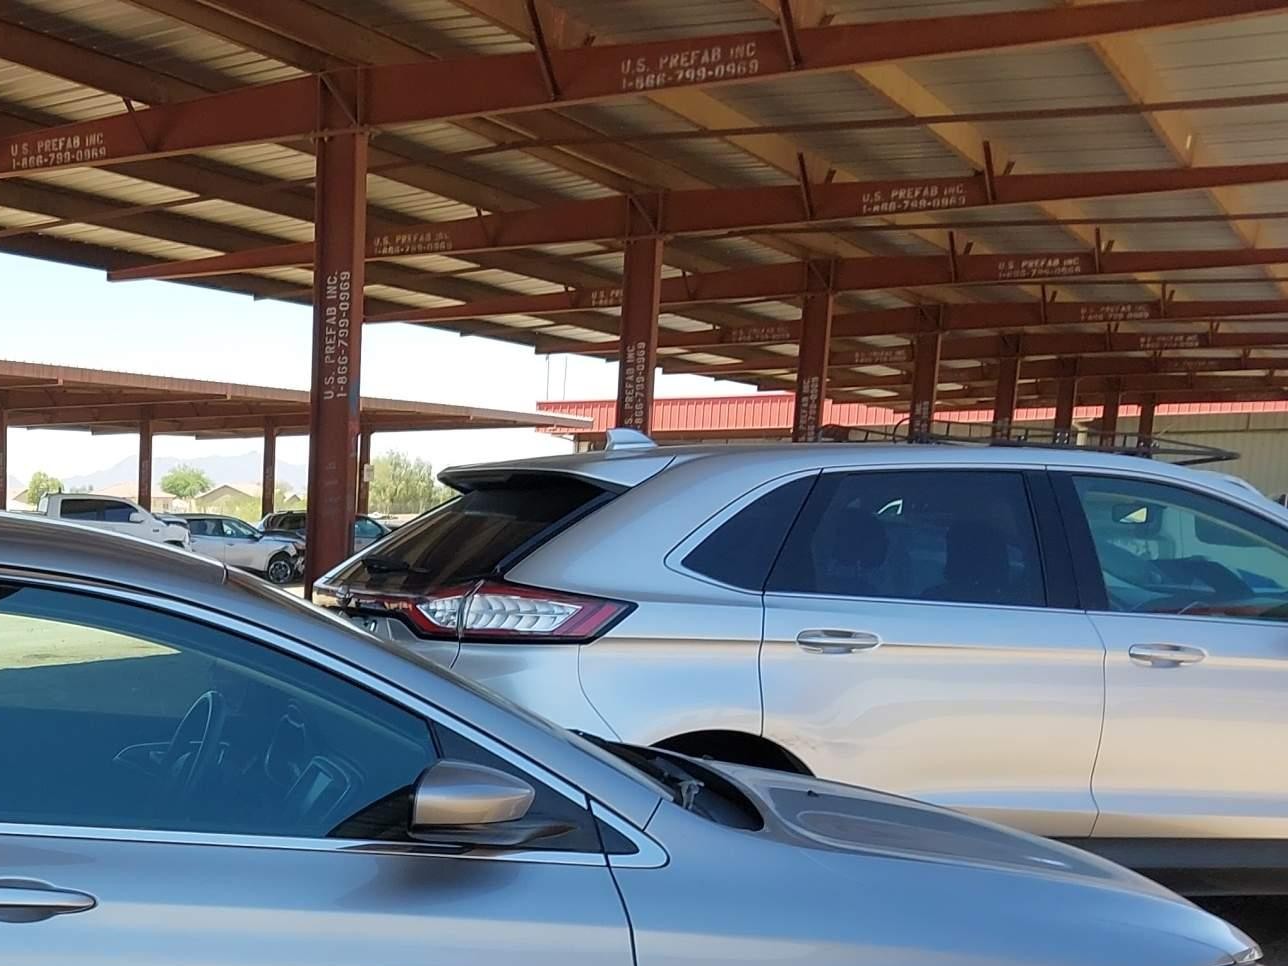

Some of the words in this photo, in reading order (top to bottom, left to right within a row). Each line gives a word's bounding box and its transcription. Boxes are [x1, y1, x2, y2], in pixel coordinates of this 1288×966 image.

[659, 48, 722, 70] PREFAB
[37, 135, 81, 153] PREFAB
[326, 270, 339, 299] INC.
[324, 306, 337, 364] PREFAB
[336, 271, 351, 399] 1-866-799-0969
[324, 370, 336, 400] U.S.
[624, 367, 636, 411] PREFAB
[633, 341, 647, 433] -866-799-0969
